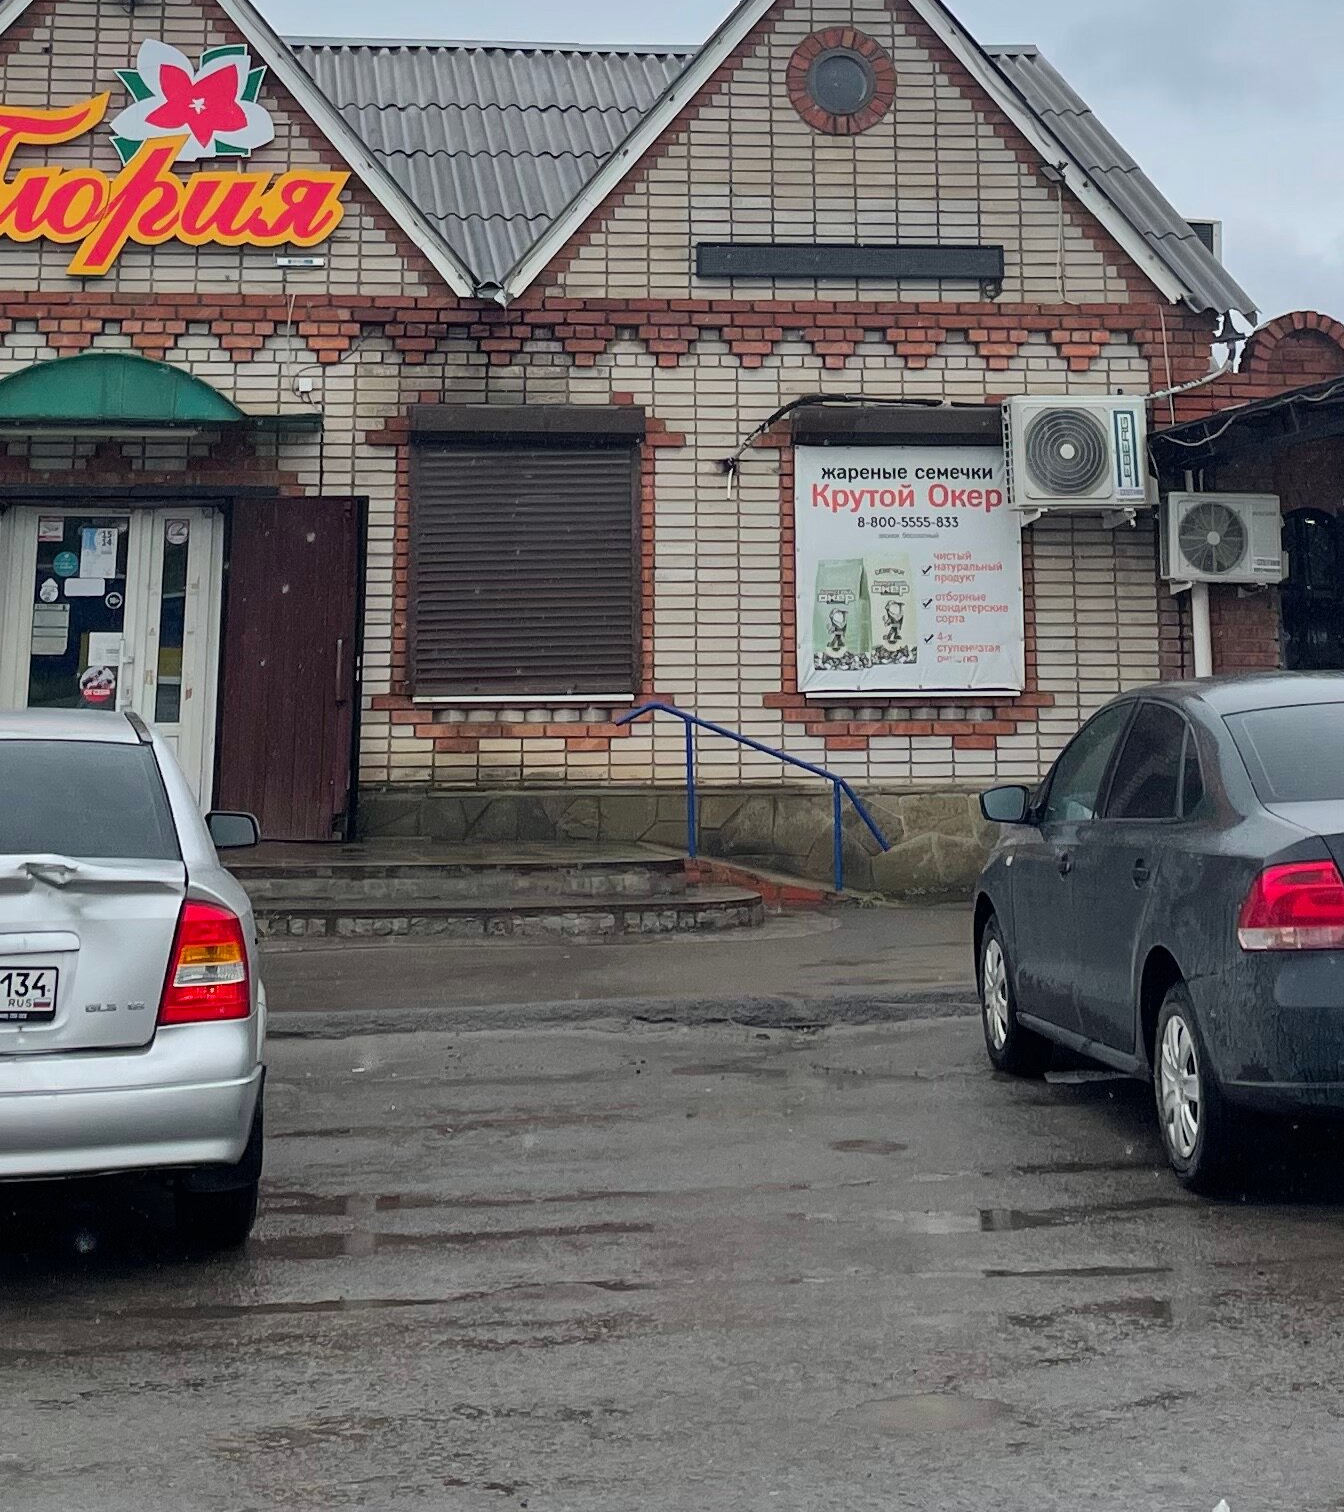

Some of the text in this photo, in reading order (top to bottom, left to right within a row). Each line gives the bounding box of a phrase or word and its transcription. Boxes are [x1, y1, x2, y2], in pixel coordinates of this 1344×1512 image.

[821, 465, 993, 483] жареные семечки
[812, 483, 1003, 513] Крутой Окер
[857, 517, 959, 528] 8-800-5555-833
[934, 551, 972, 560] чистый
[934, 561, 1003, 572] натуральный
[934, 574, 975, 584] продукт
[935, 591, 986, 603] отборные
[936, 615, 965, 624] сорта
[0, 973, 46, 998] 134
[8, 999, 32, 1007] RUS
